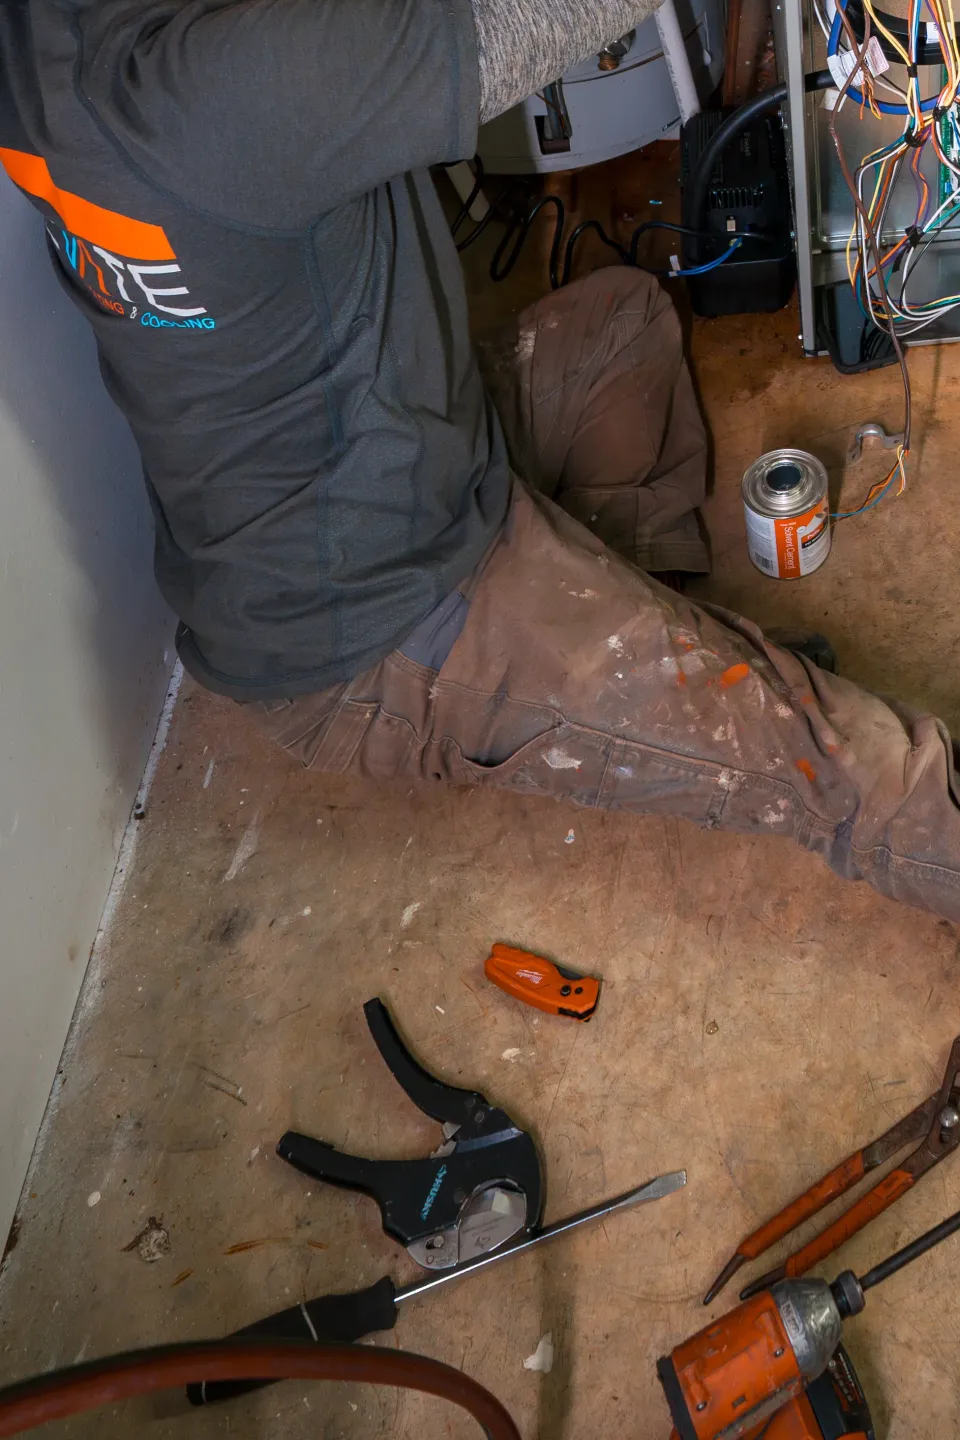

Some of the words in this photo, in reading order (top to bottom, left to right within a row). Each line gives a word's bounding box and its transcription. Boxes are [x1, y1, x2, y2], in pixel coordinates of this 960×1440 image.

[130, 306, 137, 319] &
[141, 312, 216, 329] COOLING
[784, 526, 794, 547] Solvent
[786, 547, 796, 570] Cement
[420, 1176, 442, 1221] HUSKY
